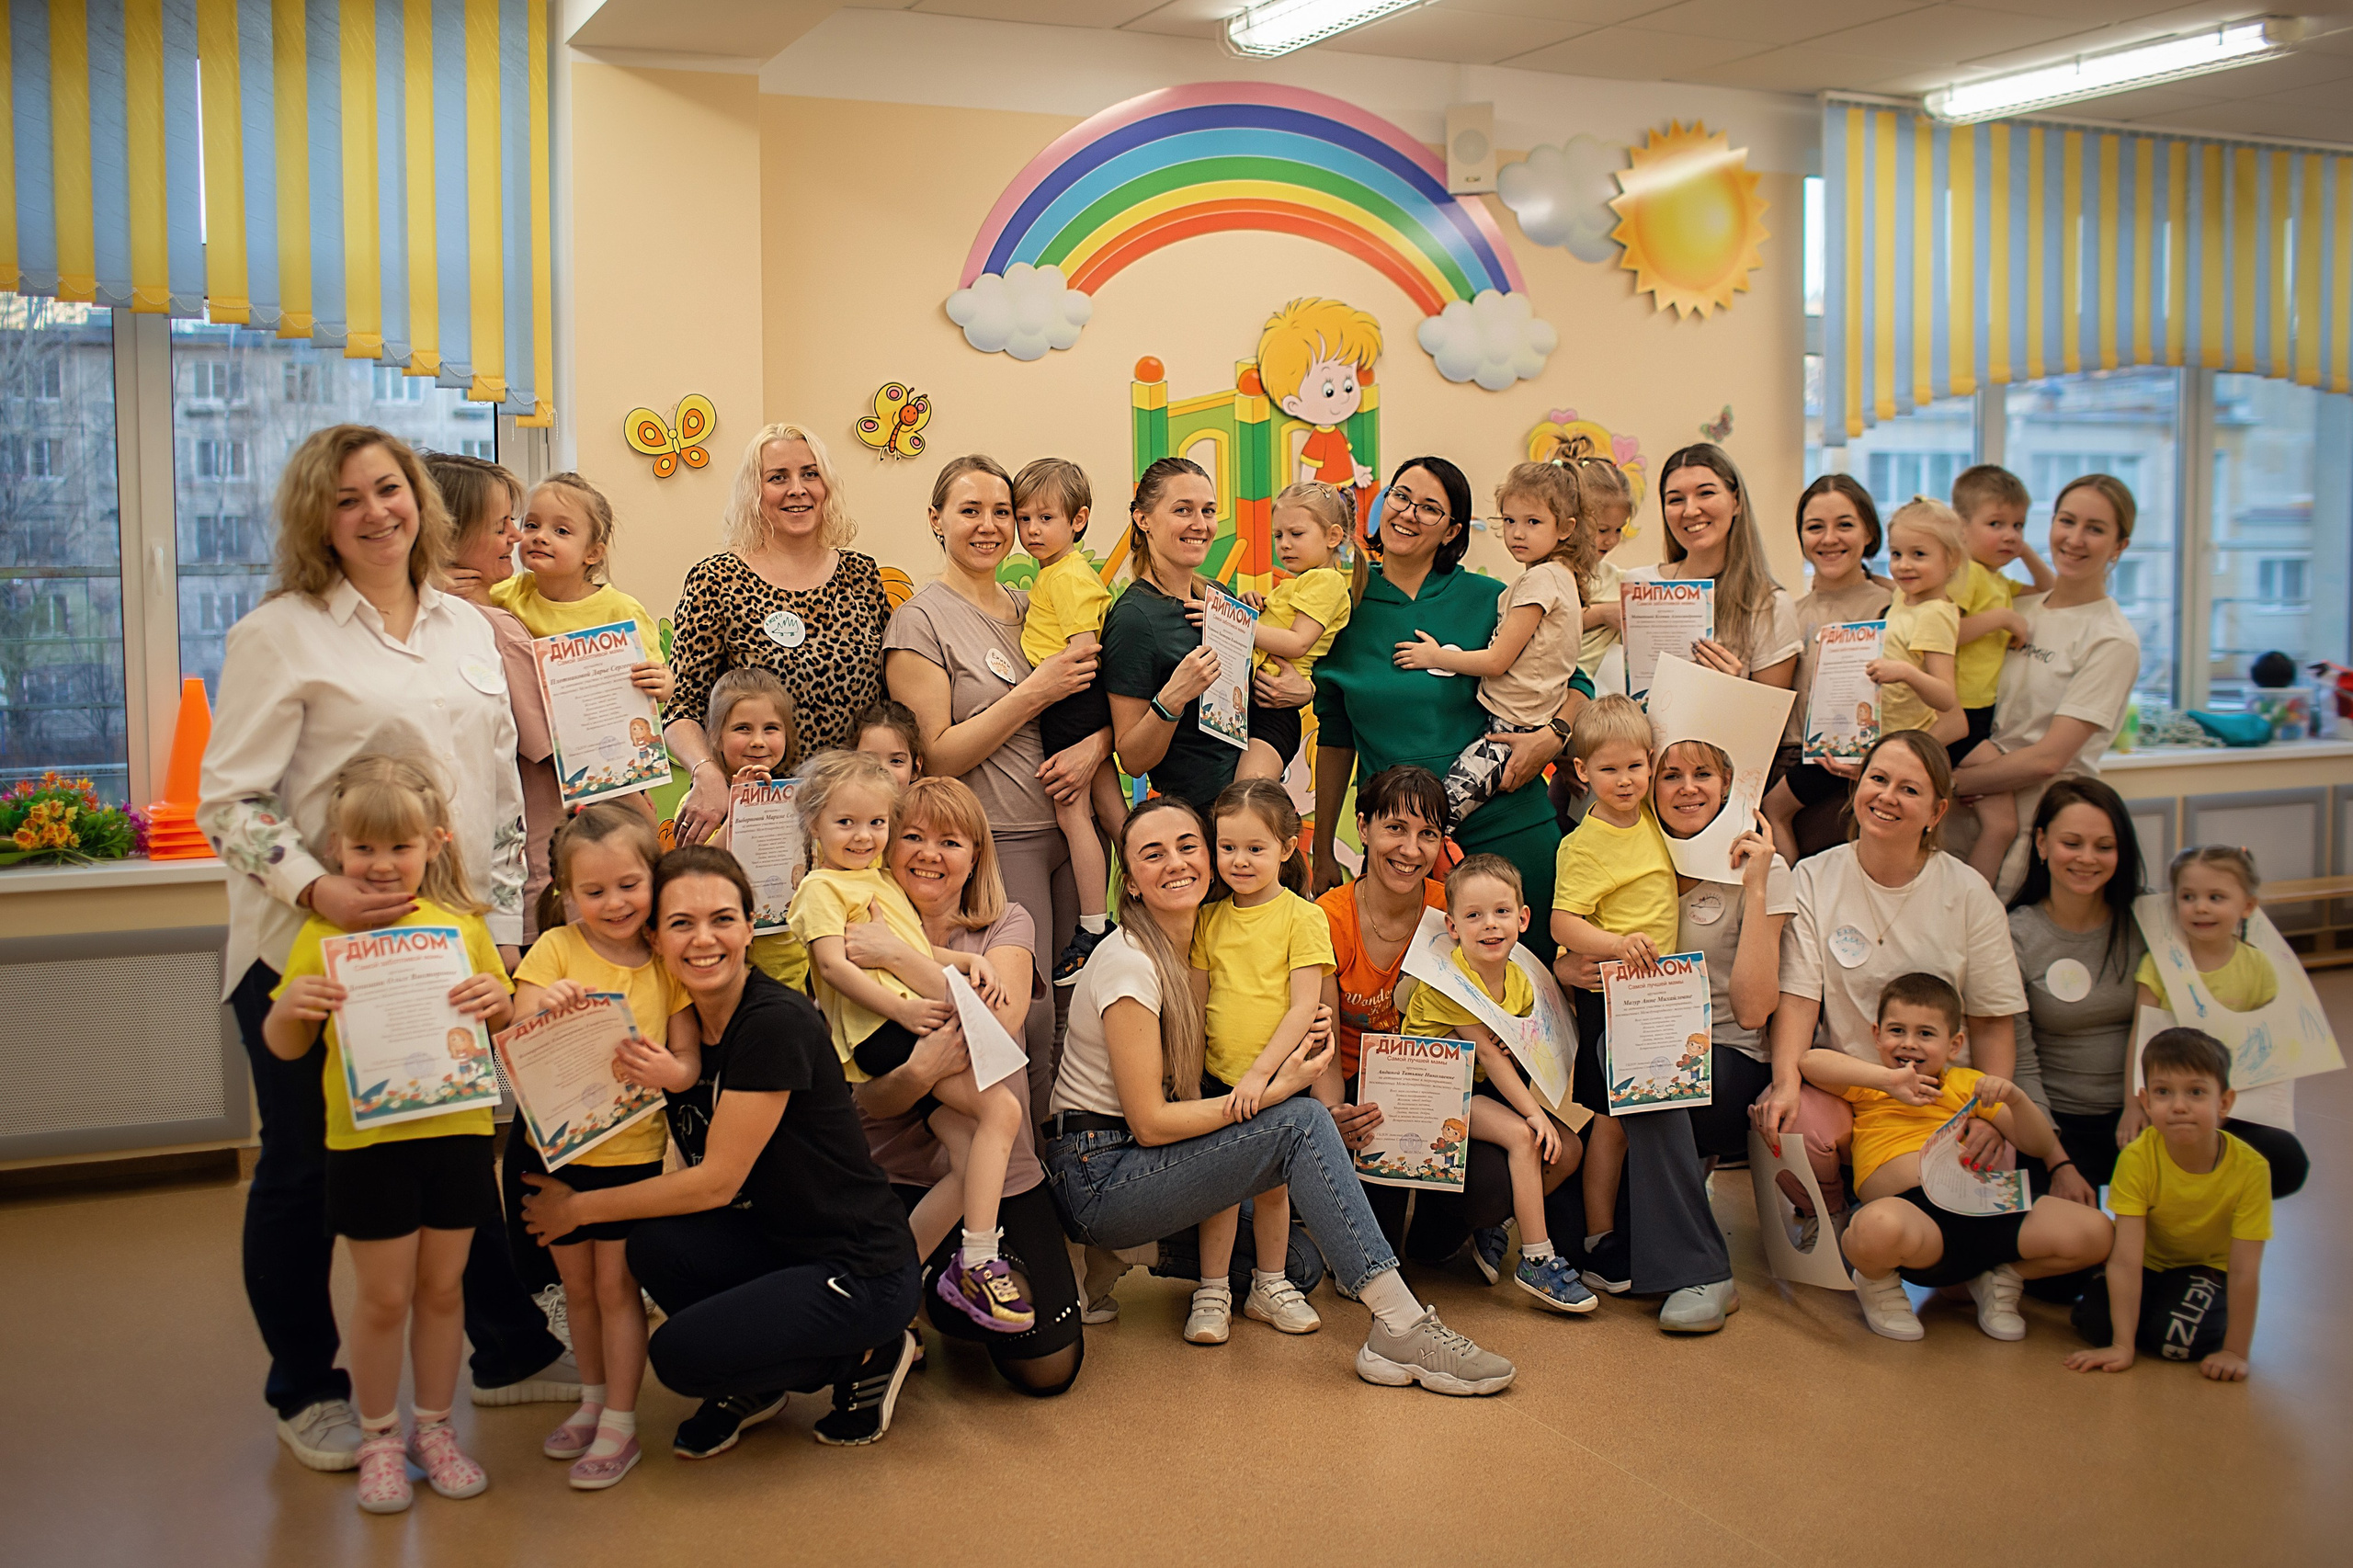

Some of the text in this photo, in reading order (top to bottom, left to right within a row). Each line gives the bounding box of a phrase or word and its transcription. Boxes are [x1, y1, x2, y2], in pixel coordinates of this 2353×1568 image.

[1632, 585, 1700, 600] ДИПЛОМ
[1211, 597, 1252, 628] ДИПЛОМ
[1826, 627, 1877, 644] ДИПЛОМ
[550, 631, 628, 662] ДИПЛОМ
[740, 785, 795, 804] ДИПЛО
[346, 933, 448, 962] ДИПЛОМ
[1345, 988, 1392, 1006] Wonde
[1376, 1040, 1461, 1060] ДИПЛОМ
